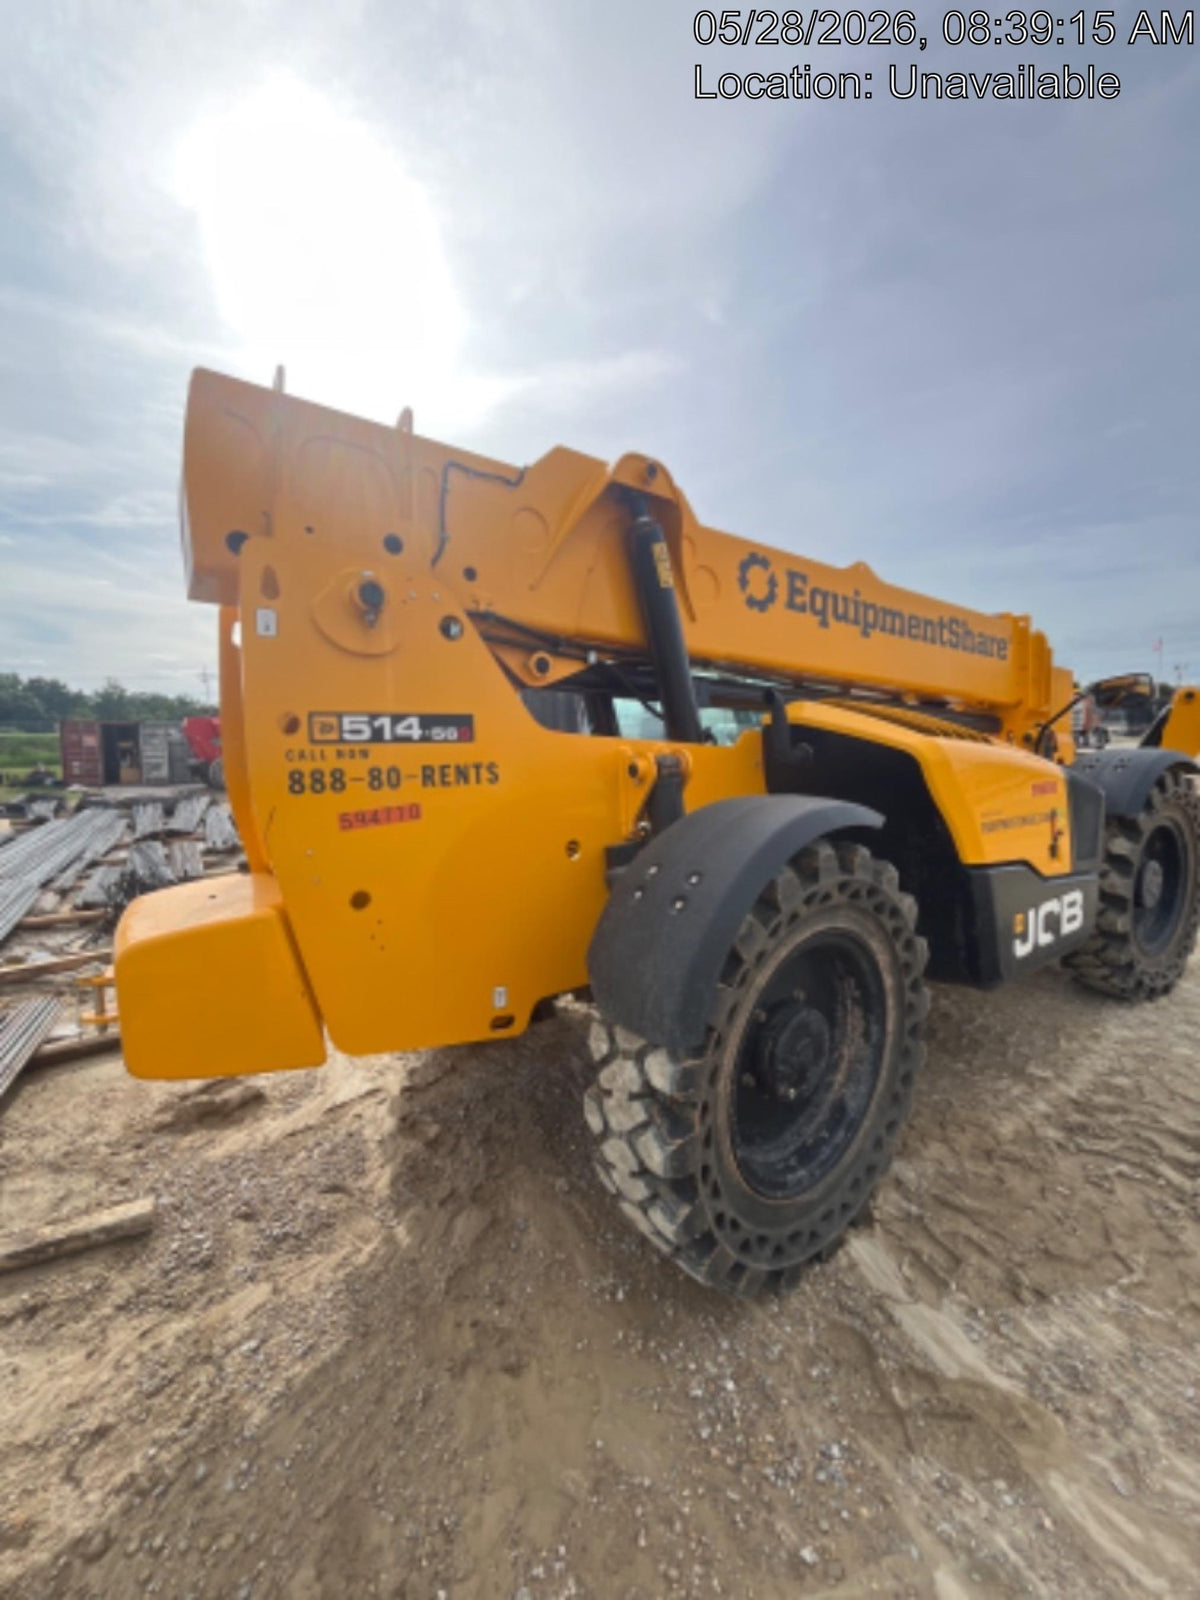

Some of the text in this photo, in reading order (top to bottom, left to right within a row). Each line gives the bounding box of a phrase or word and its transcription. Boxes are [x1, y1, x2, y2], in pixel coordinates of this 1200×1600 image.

[785, 569, 1008, 661] EquipmentShare
[288, 763, 500, 795] 888-80-RENTS
[1013, 889, 1084, 959] JCB
